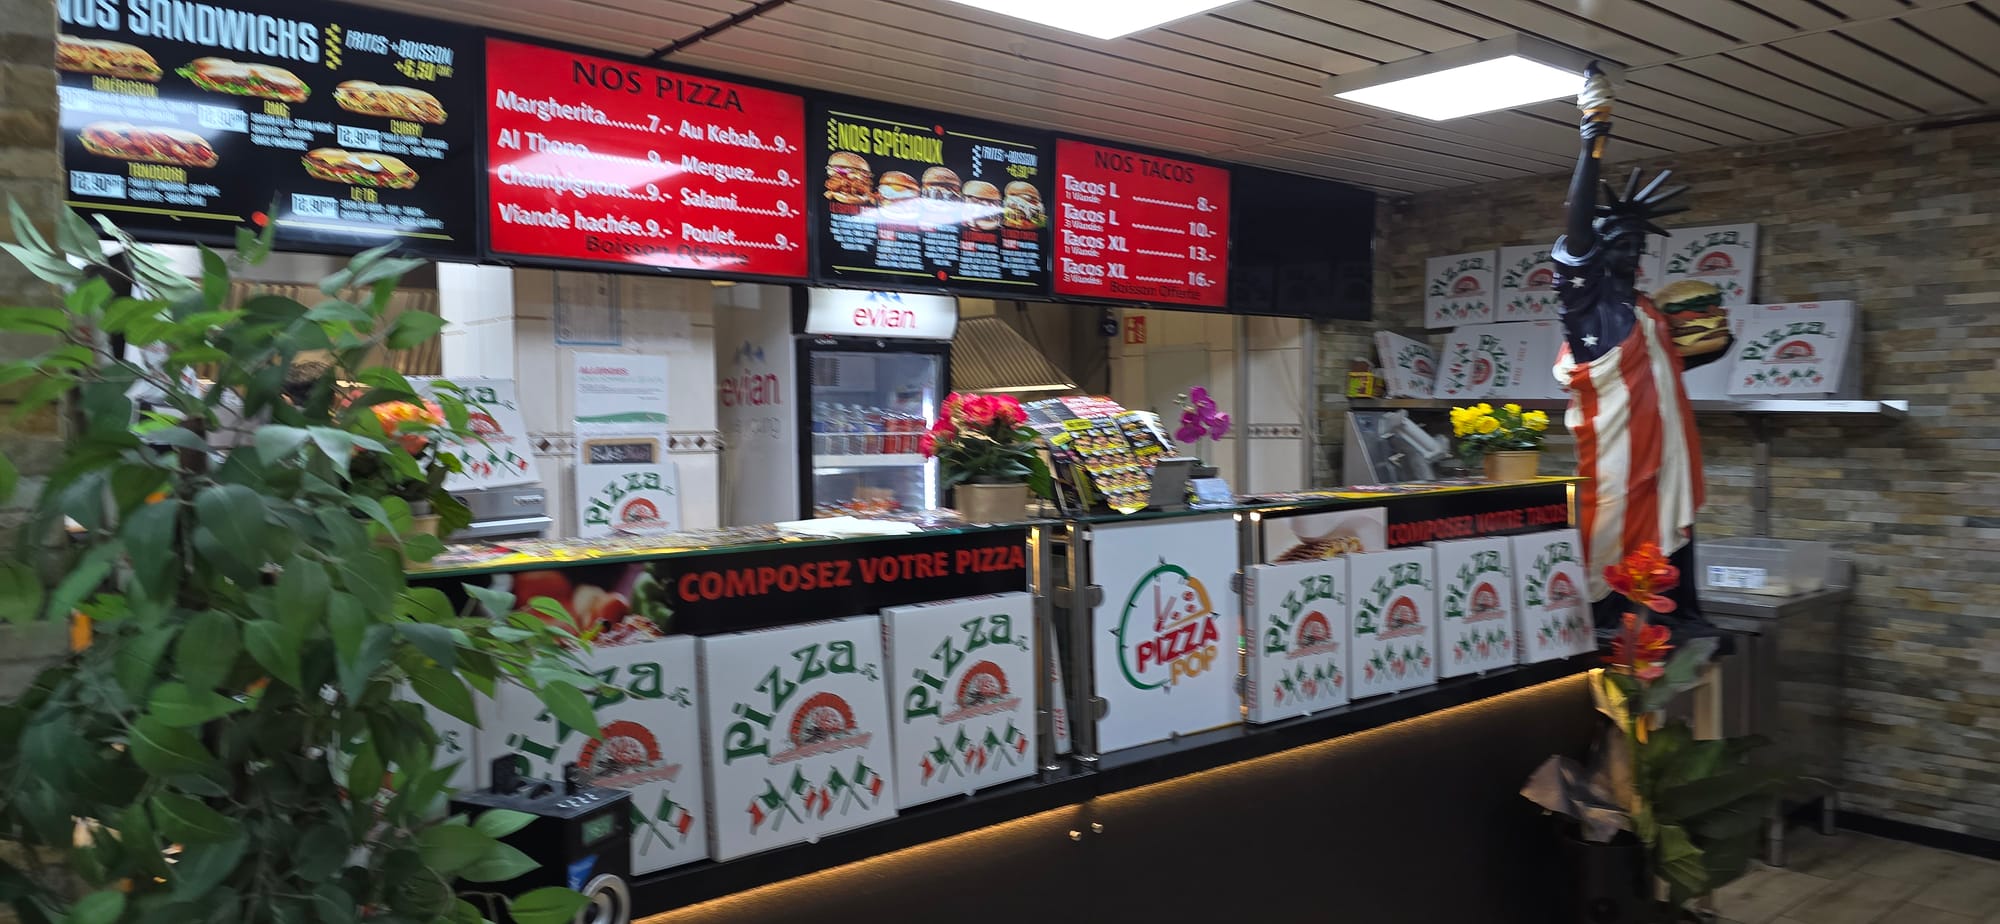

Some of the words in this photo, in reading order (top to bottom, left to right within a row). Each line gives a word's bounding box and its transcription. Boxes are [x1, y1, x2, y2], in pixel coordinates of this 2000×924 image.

[127, 0, 320, 64] SANDWICHS
[345, 29, 389, 55] FRITES
[399, 39, 454, 66] BOISSON
[571, 60, 643, 94] NOS
[655, 74, 744, 113] PIZZA
[390, 119, 423, 138] CURRY
[496, 128, 521, 151] Al
[678, 119, 704, 141] Au
[837, 122, 872, 154] NOS
[872, 126, 944, 166] SPÉCIAUX
[128, 162, 187, 184] TANDOORI
[1094, 150, 1133, 173] NOS
[1140, 158, 1195, 183] TACOS
[1062, 174, 1106, 196] Tacos
[1109, 181, 1121, 199] L
[497, 202, 570, 229] Viande
[1061, 202, 1106, 224] Tacos
[1109, 209, 1120, 226] L
[586, 235, 671, 257] Boisson
[1061, 229, 1105, 250] Tacos
[1107, 234, 1130, 253] XL
[1060, 257, 1105, 277] Tacos
[1107, 262, 1129, 280] XL
[1111, 281, 1157, 296] Boisson
[853, 304, 916, 329] evian
[720, 365, 782, 408] evian
[1388, 515, 1474, 546] COMPOSEZ
[1475, 509, 1525, 533] VOTRE
[678, 559, 852, 602] COMPOSEZ
[858, 551, 949, 584] VOTRE
[955, 544, 1026, 575] PIZZA
[1136, 617, 1220, 673] PIZZA
[1171, 645, 1218, 686] POP
